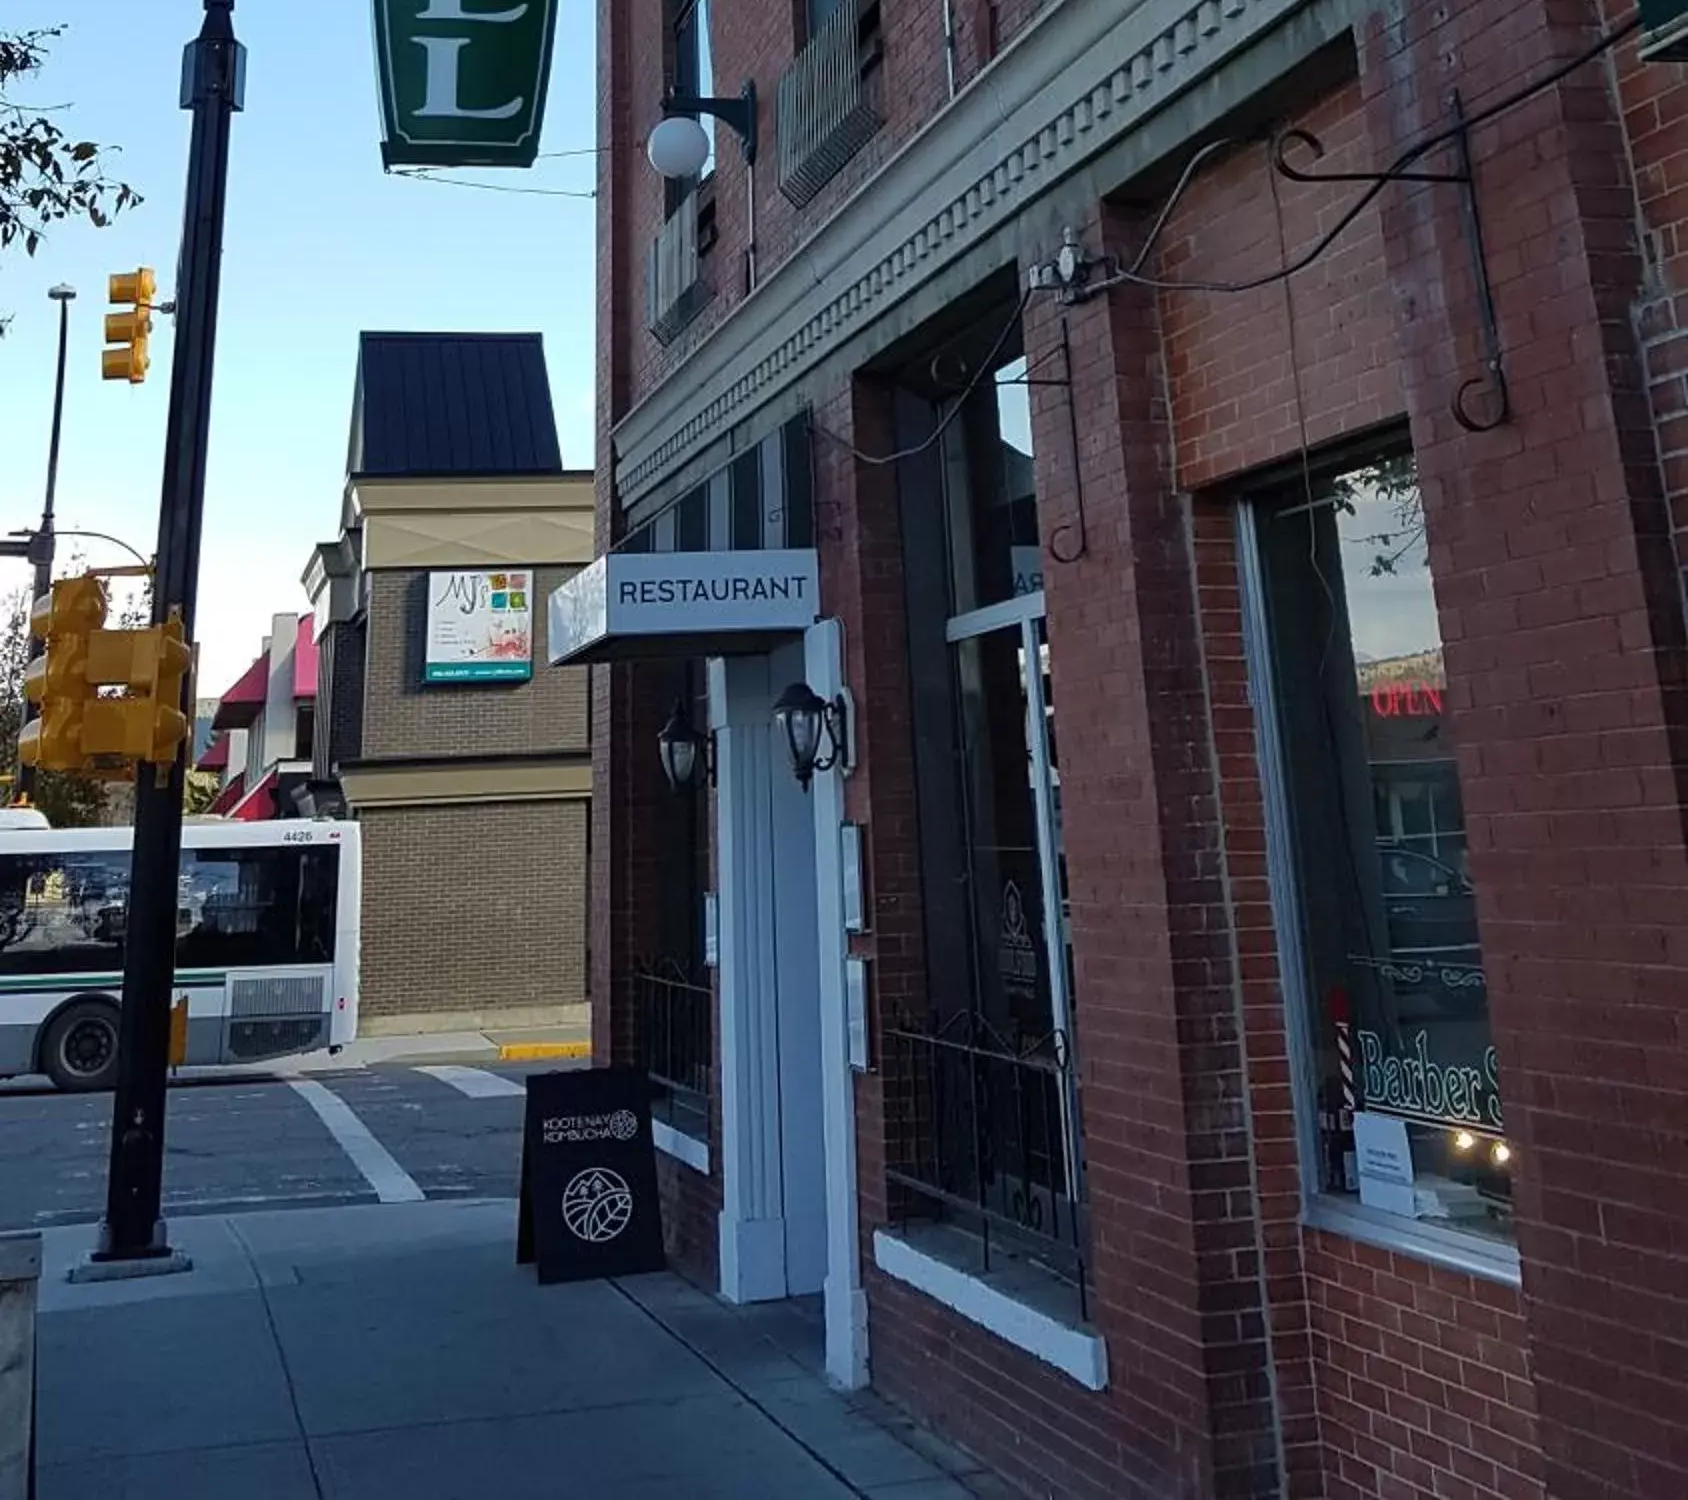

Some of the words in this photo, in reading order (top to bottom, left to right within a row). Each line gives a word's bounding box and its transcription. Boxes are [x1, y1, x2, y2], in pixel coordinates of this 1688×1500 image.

[619, 576, 808, 604] RESTAURANT
[1371, 680, 1444, 717] OPEN
[1358, 1029, 1481, 1121] Barber
[543, 1113, 611, 1131] KOOTENAY
